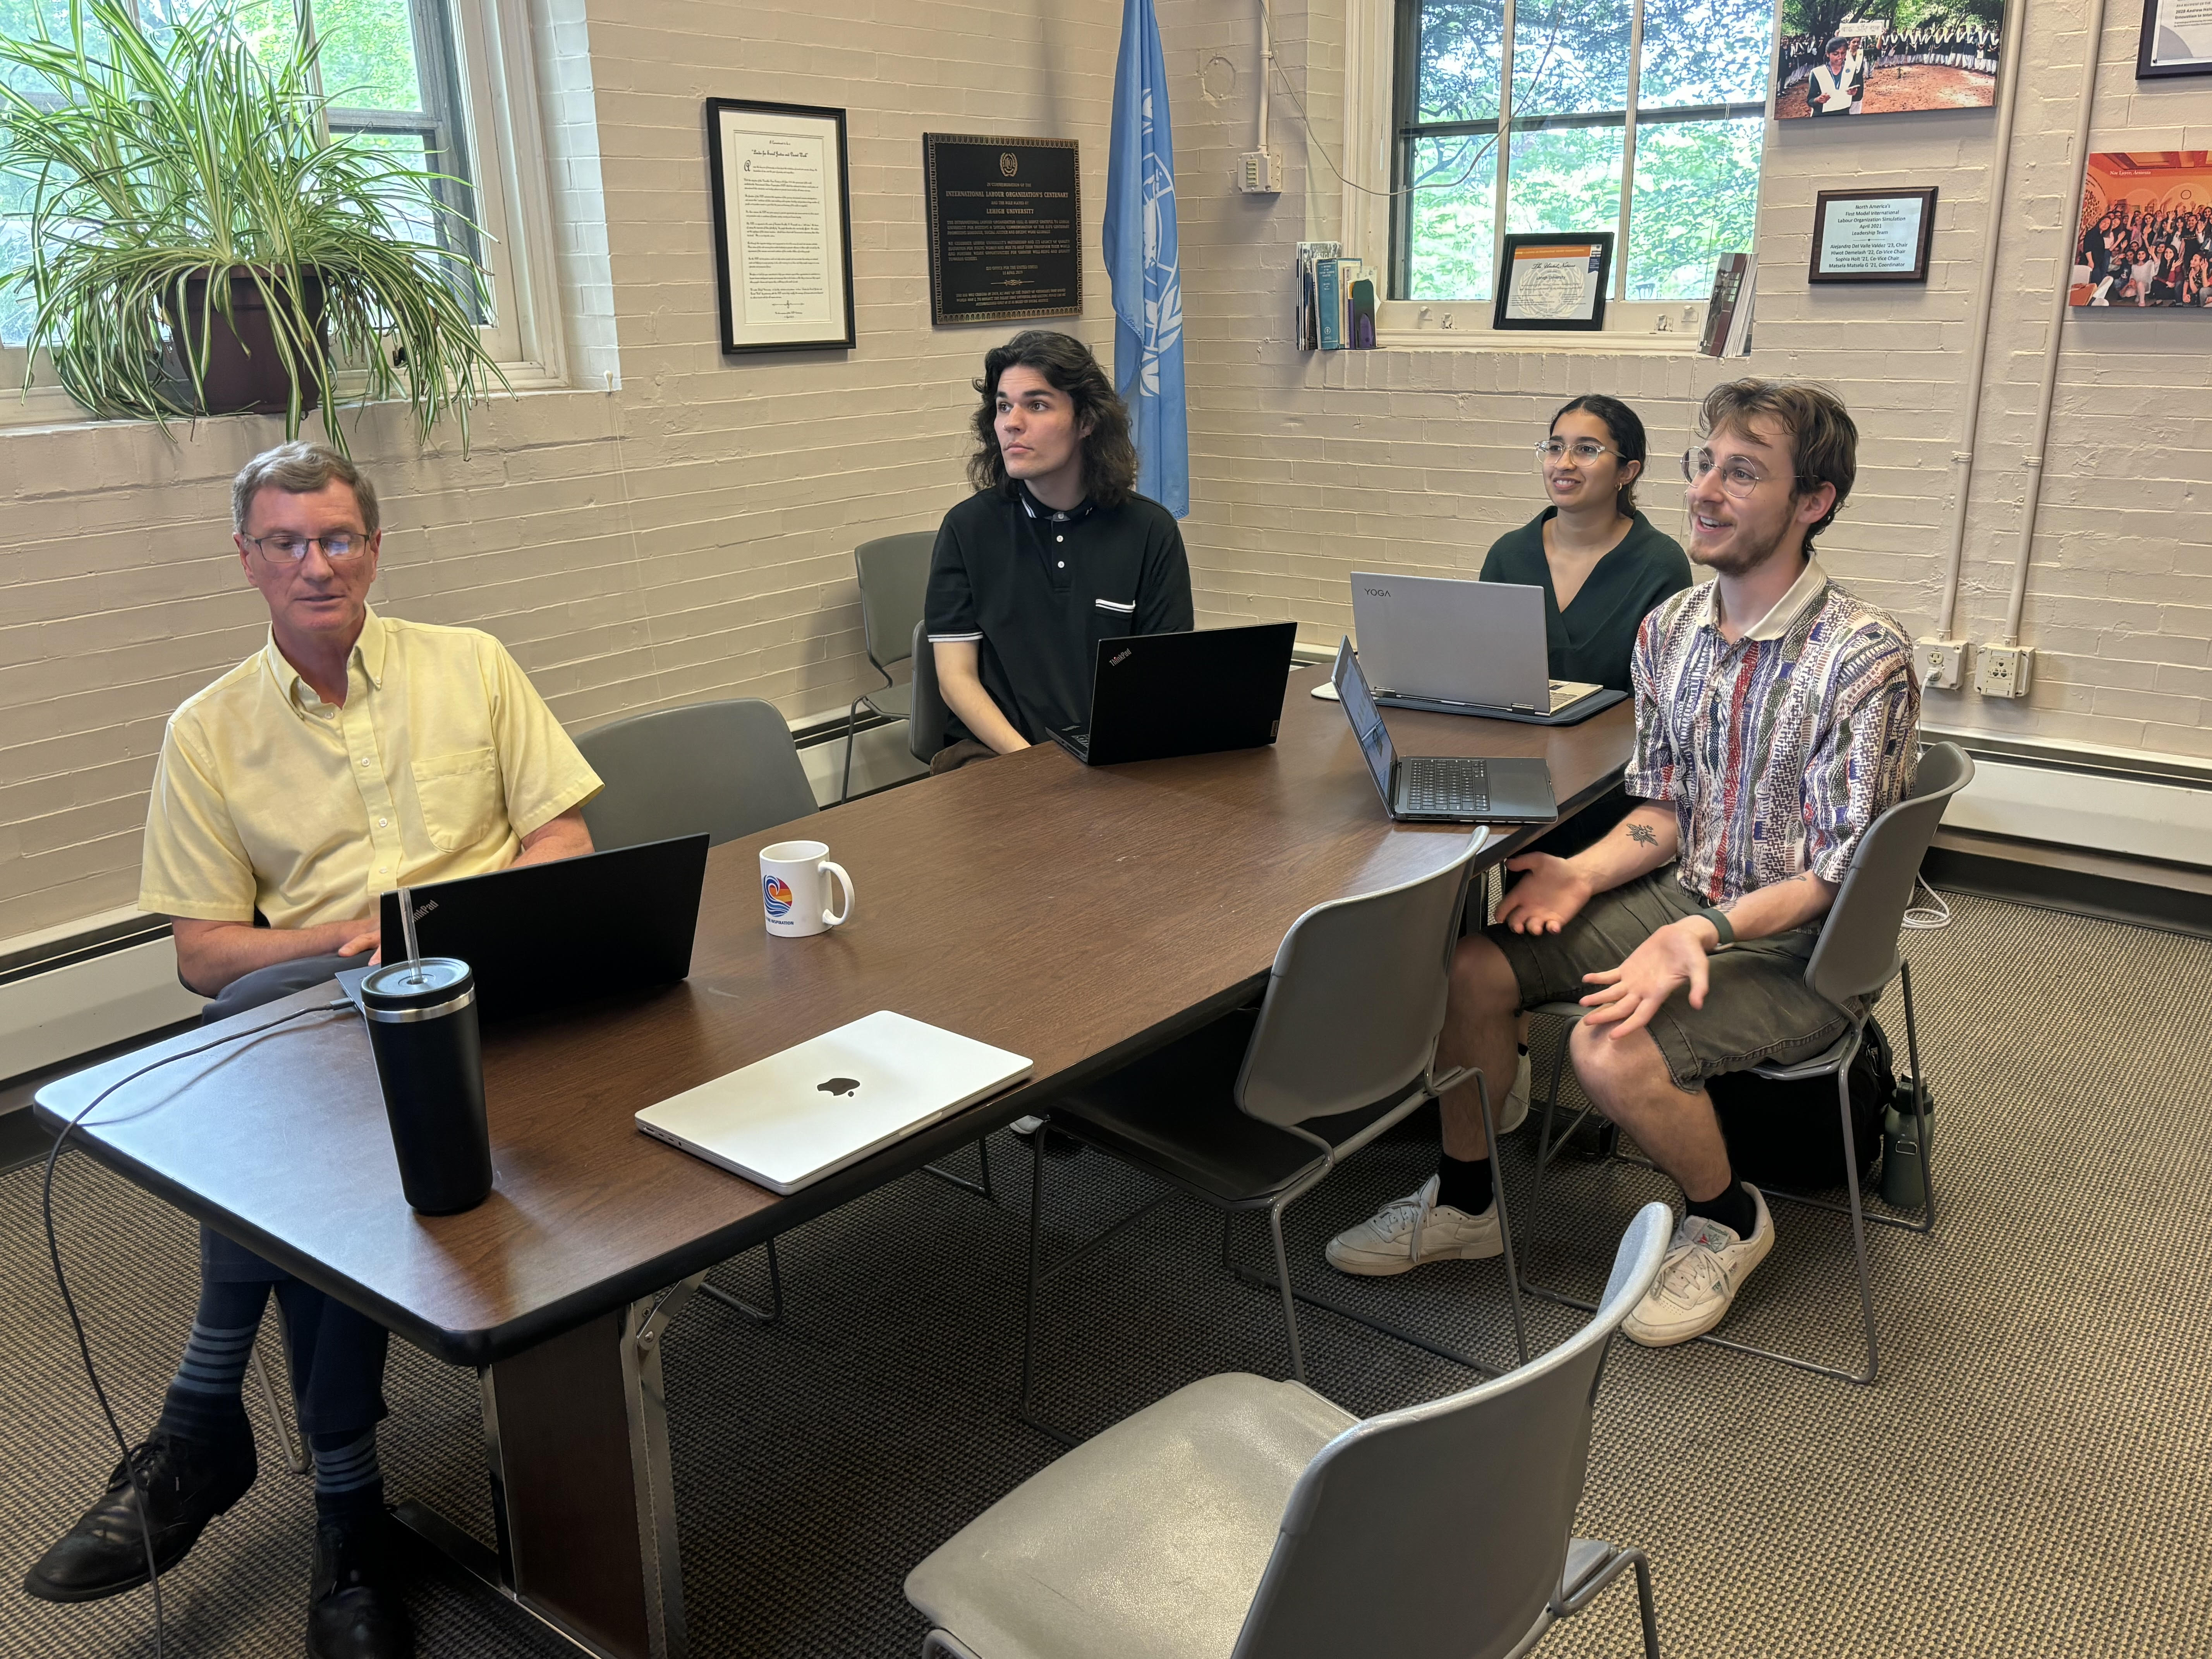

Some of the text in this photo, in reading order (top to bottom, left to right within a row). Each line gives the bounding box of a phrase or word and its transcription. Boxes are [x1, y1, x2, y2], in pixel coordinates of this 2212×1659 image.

[1364, 588, 1391, 597] YOGA
[1109, 648, 1132, 666] ThinkPad
[413, 899, 439, 922] inkPad
